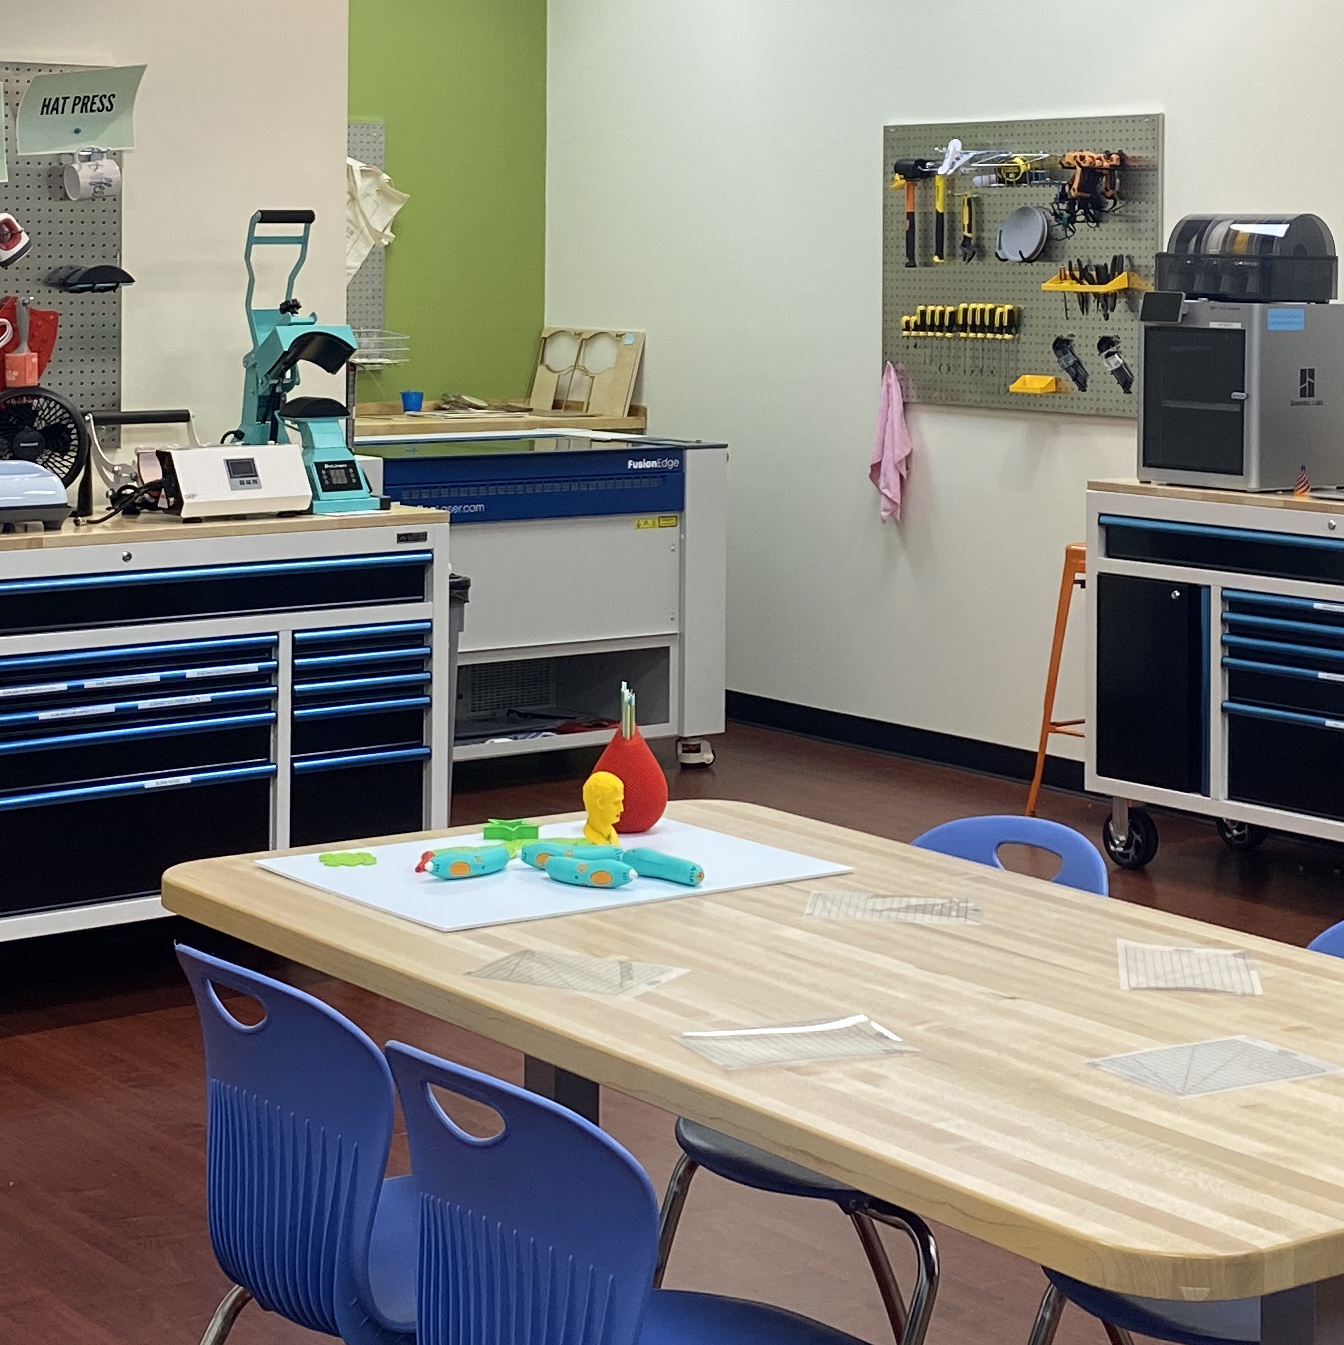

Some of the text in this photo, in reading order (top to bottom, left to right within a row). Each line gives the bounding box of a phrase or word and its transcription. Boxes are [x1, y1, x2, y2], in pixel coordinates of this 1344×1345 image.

[39, 93, 116, 116] HAT PRESS
[627, 458, 680, 470] FusionEdge
